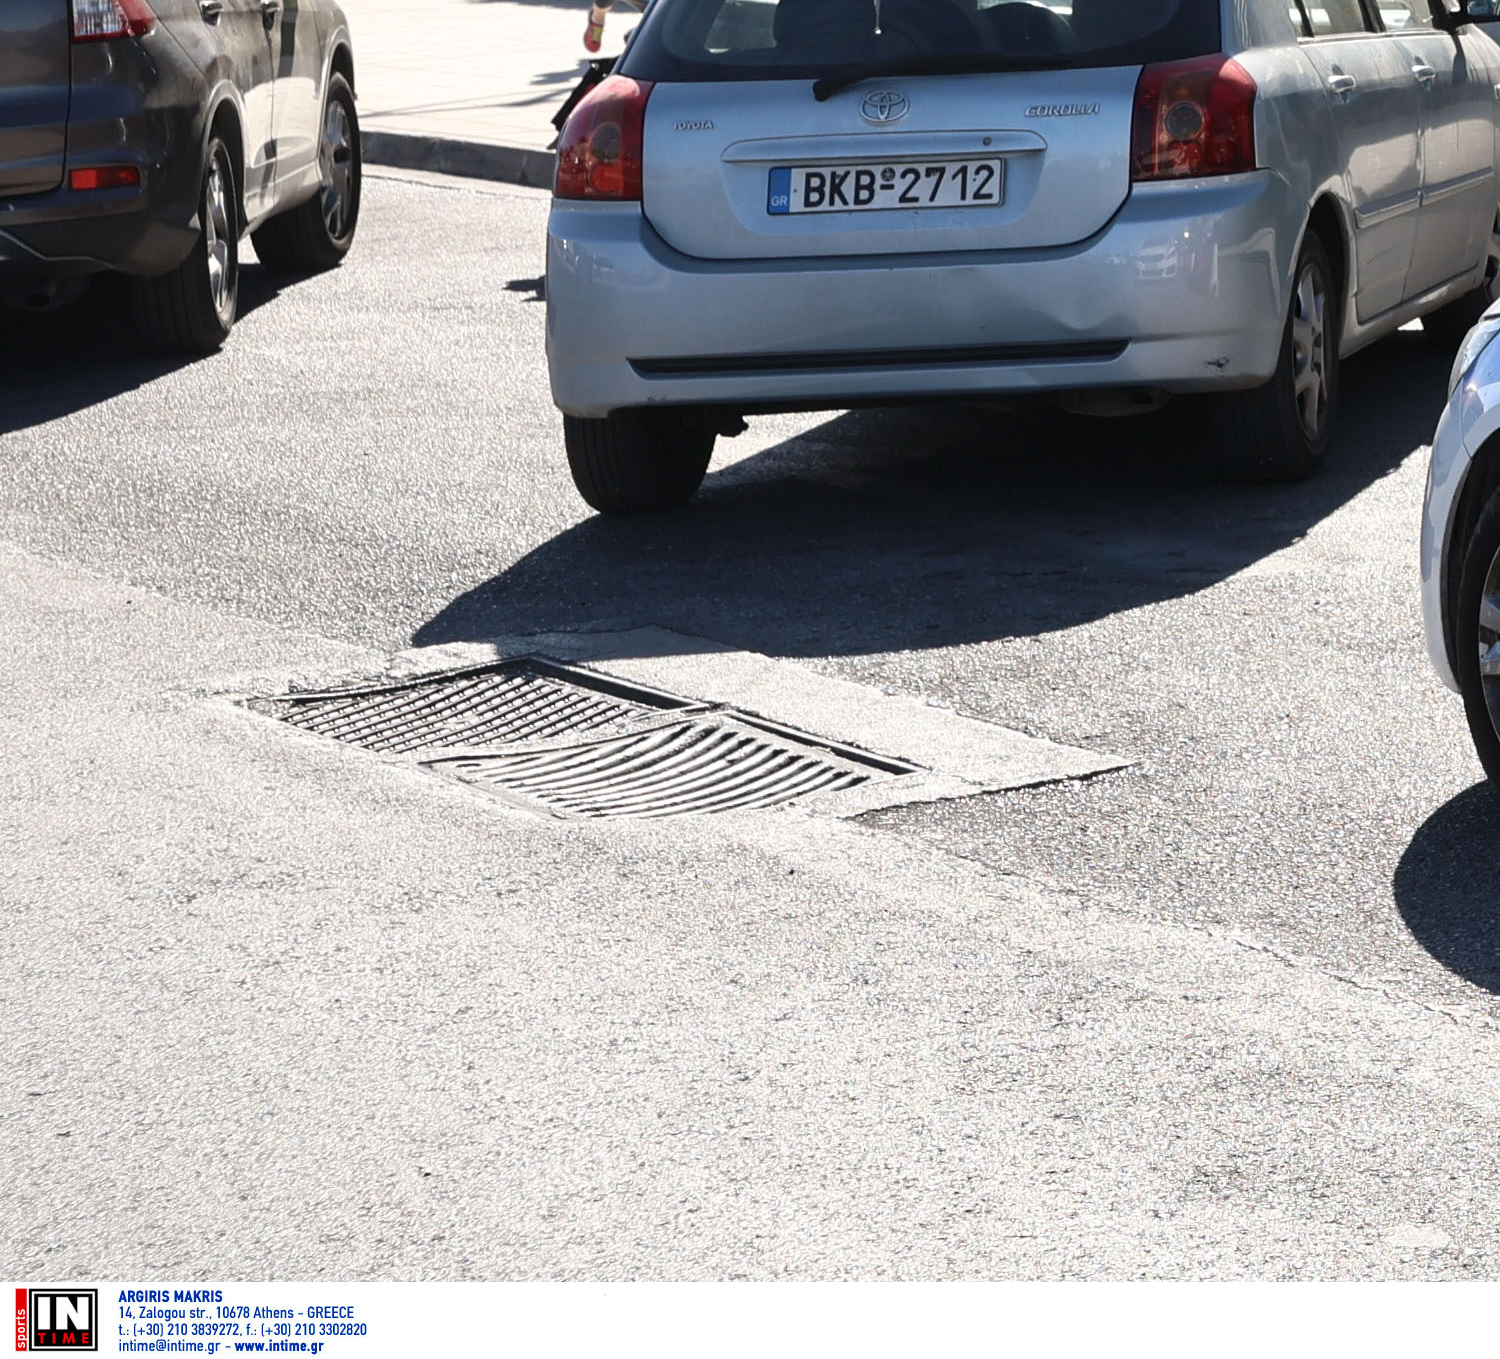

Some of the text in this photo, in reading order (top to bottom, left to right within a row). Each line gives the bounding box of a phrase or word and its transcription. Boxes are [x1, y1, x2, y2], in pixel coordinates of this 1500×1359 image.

[1024, 103, 1101, 118] COROLLA
[673, 120, 714, 131] TOYOTA
[771, 195, 788, 207] GR
